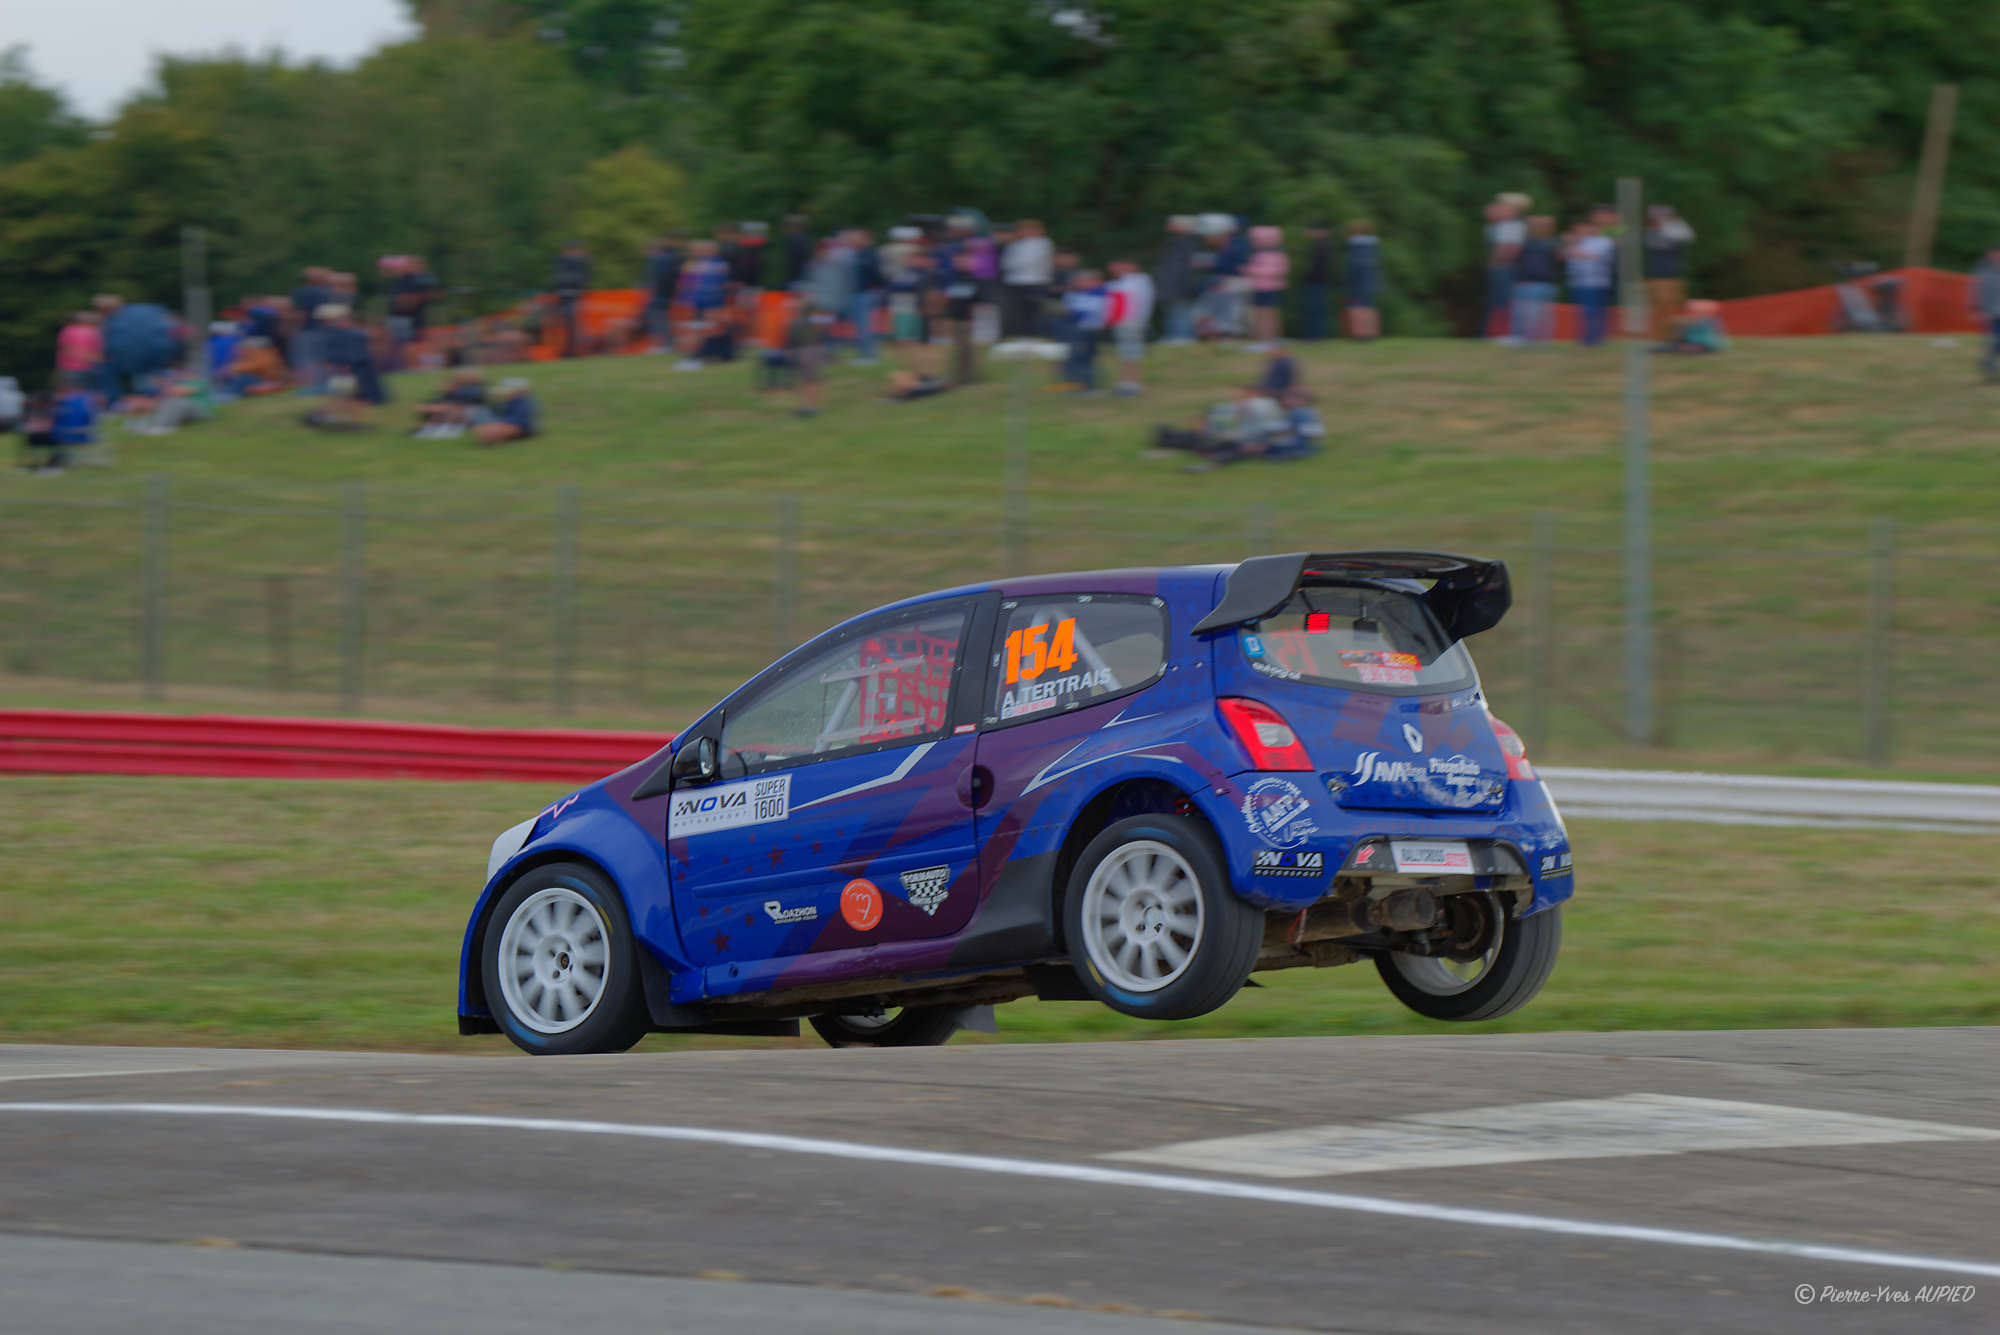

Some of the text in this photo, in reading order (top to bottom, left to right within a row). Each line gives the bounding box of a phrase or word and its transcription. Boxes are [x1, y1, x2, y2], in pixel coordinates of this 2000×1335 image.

[1004, 617, 1079, 685] 154
[755, 779, 786, 797] SUPER
[675, 791, 746, 817] NOVA
[753, 797, 784, 820] 1600
[1256, 851, 1322, 867] NOVA
